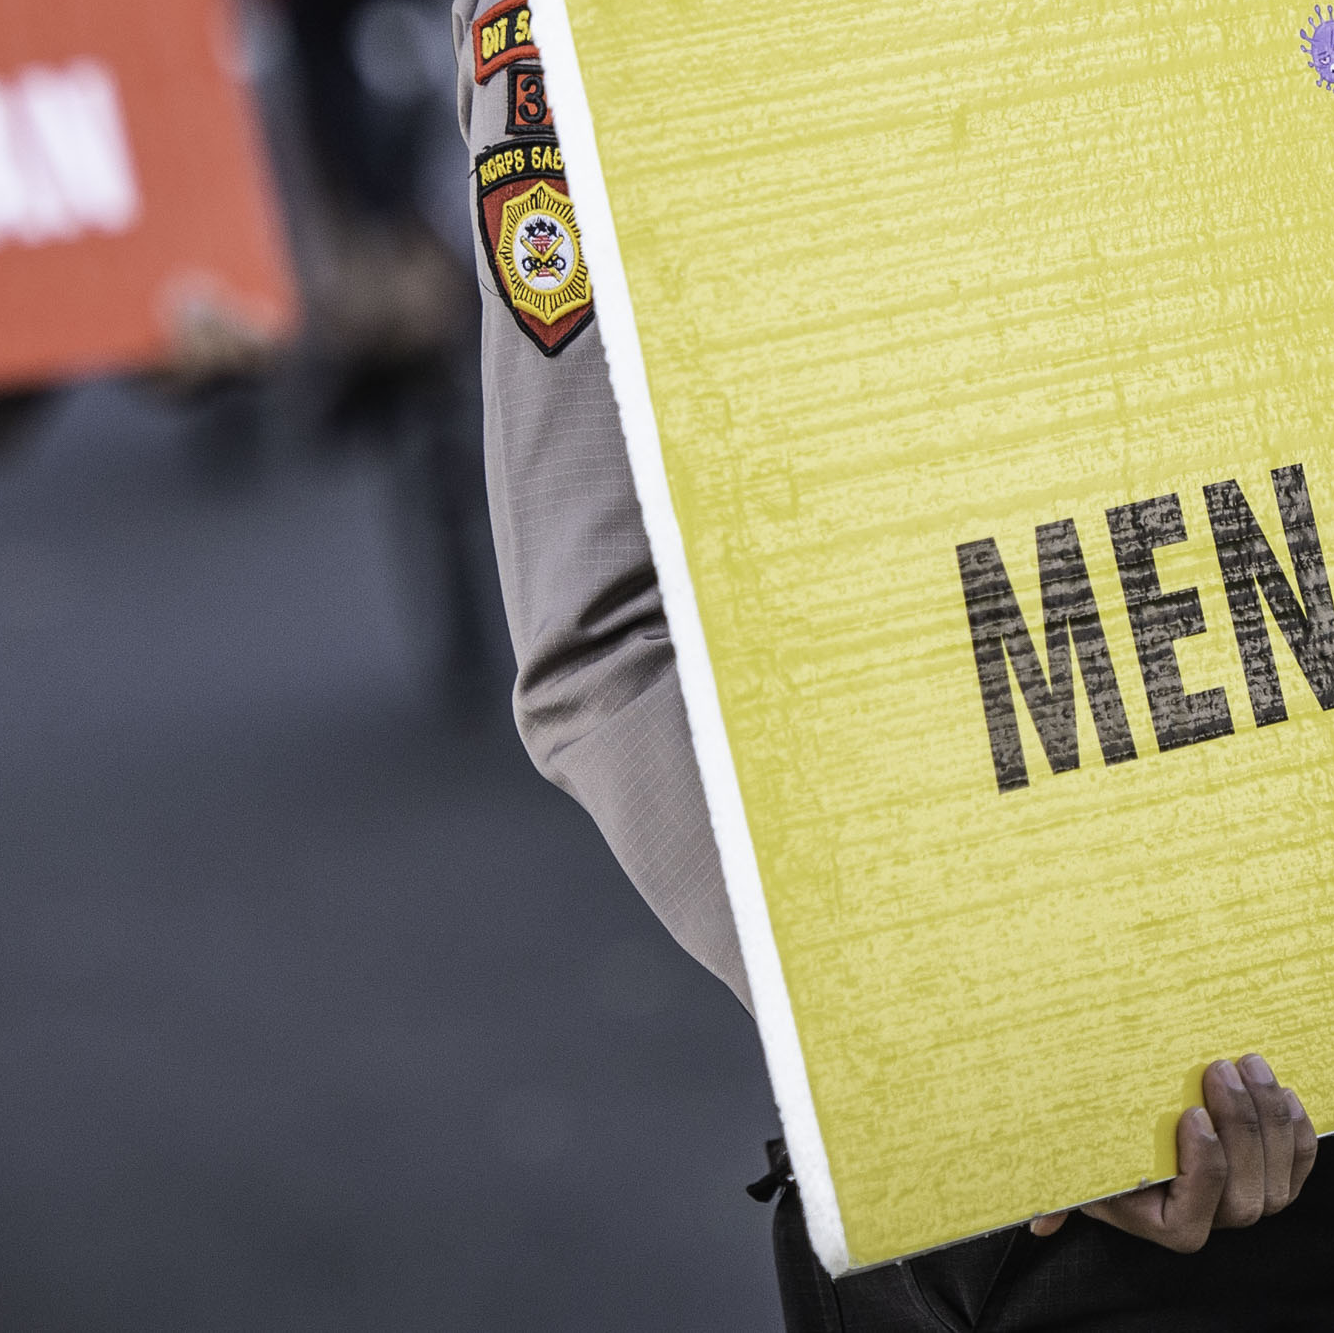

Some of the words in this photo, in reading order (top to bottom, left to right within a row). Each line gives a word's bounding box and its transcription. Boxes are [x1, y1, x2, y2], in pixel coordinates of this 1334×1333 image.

[481, 17, 508, 59] DIT
[514, 9, 532, 44] S
[479, 148, 525, 186] KORPS
